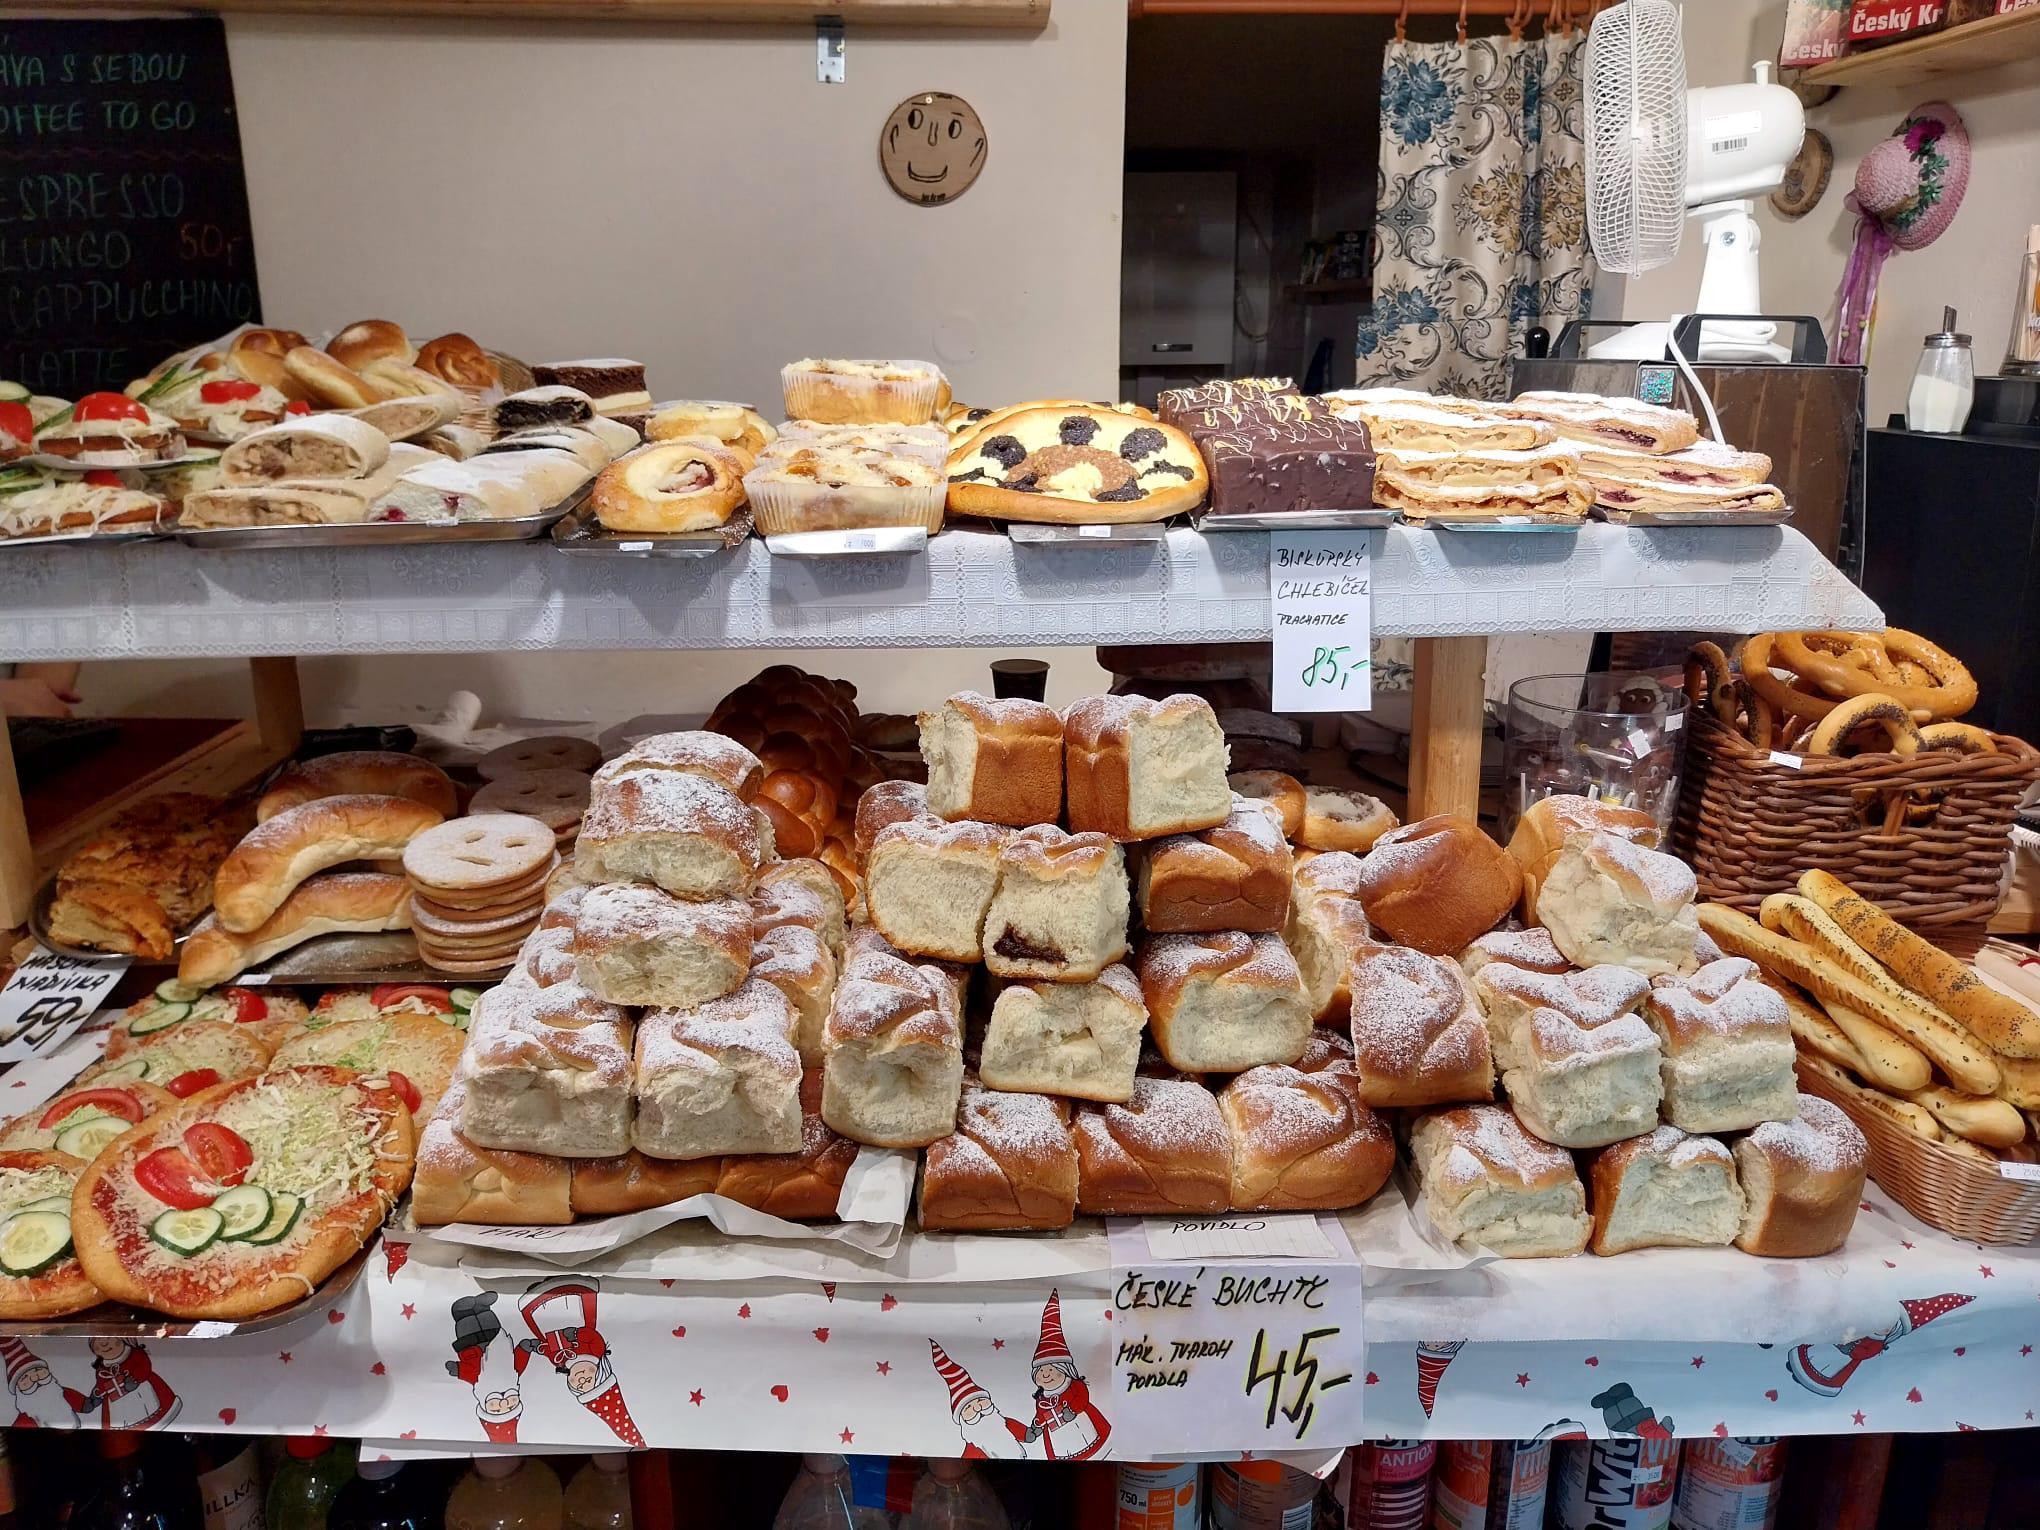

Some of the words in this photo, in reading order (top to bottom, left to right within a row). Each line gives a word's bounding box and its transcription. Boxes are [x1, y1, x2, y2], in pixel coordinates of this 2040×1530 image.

[1852, 6, 1912, 34] Český
[60, 54, 75, 83] S
[90, 54, 187, 85] SEBOU
[101, 101, 139, 131] TO
[151, 102, 195, 131] GO
[0, 229, 131, 271] LUNGO
[20, 348, 128, 386] LATTE
[1277, 544, 1367, 567] BISKUPSKÝ
[1277, 575, 1370, 599] CHLEBÍČEK
[1171, 1220, 1267, 1234] POVIDLO
[1115, 1267, 1206, 1310] ČESKÉ
[1212, 1275, 1330, 1310] BUCHTY
[1170, 1339, 1234, 1364] TVAROH
[1119, 1488, 1138, 1506] 750
